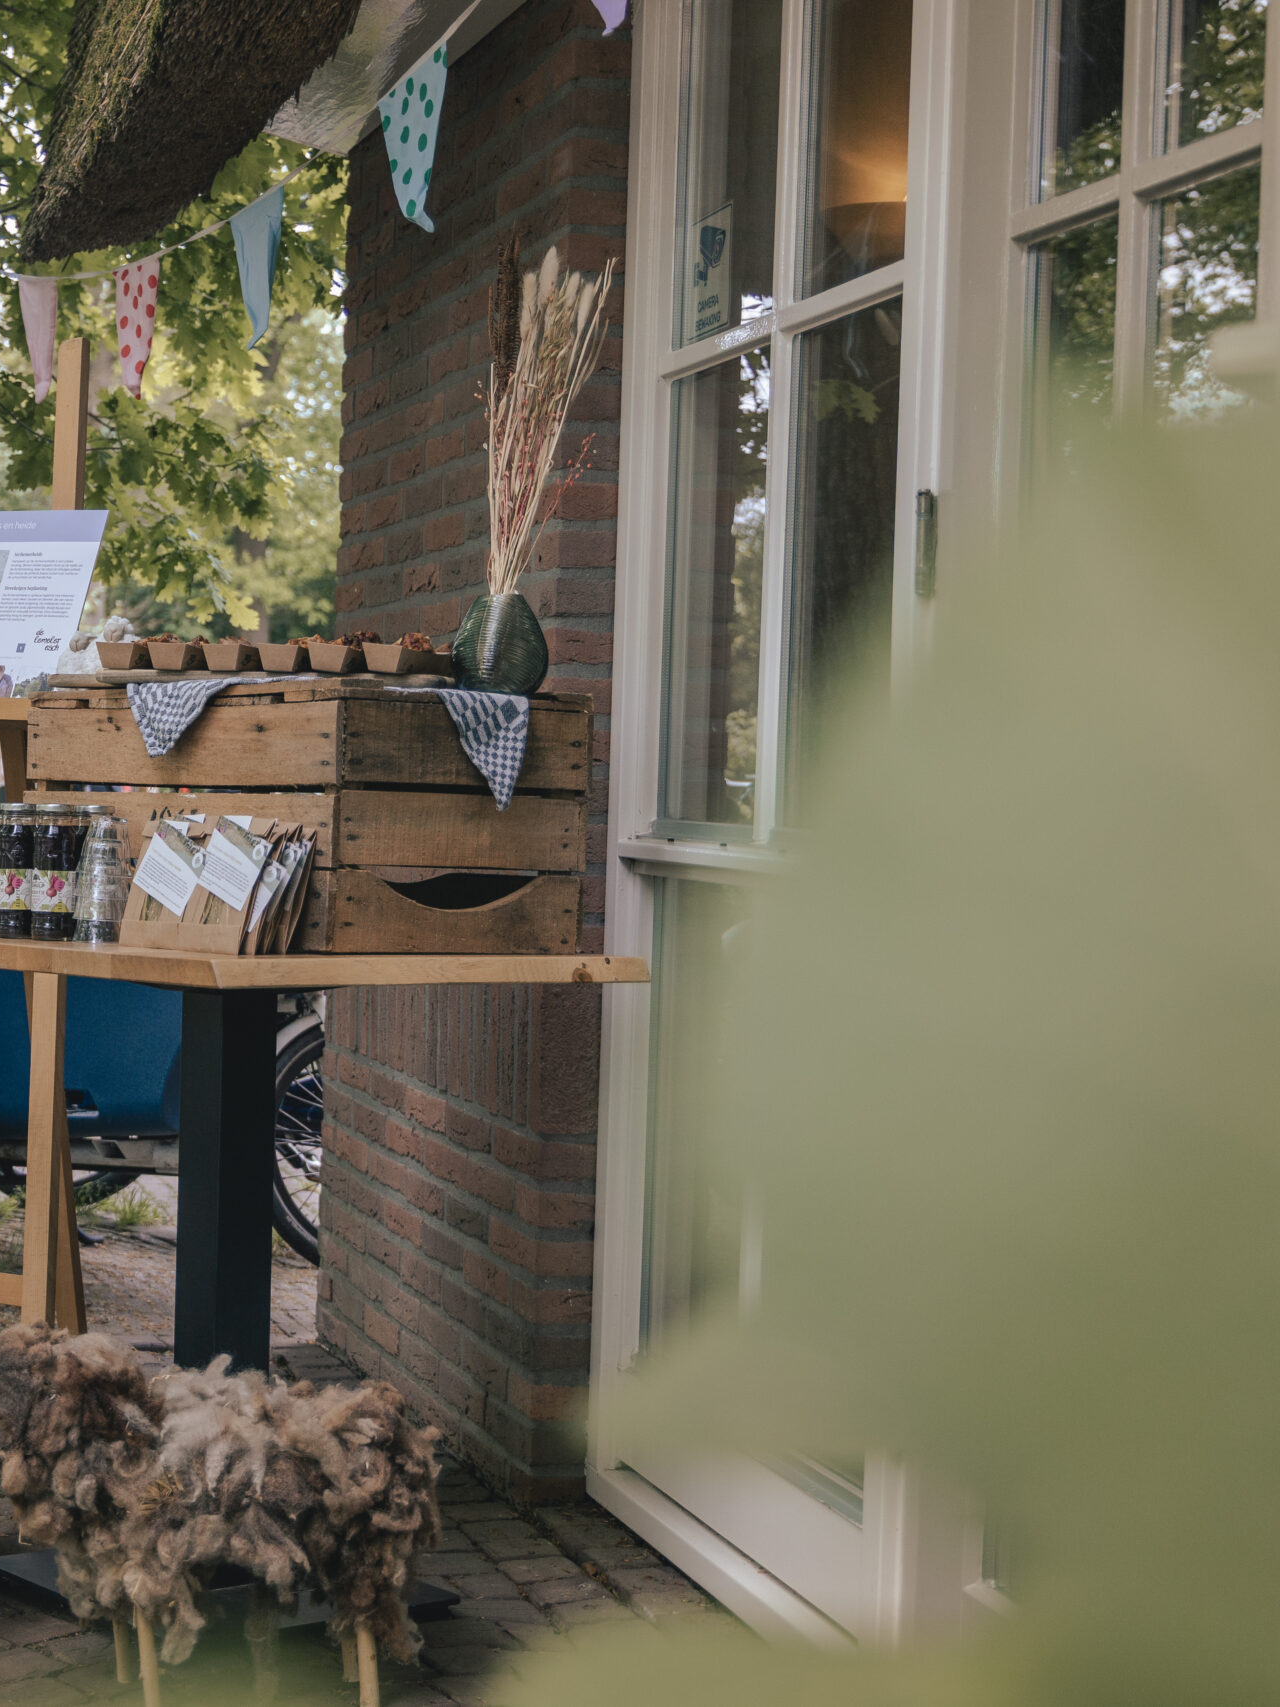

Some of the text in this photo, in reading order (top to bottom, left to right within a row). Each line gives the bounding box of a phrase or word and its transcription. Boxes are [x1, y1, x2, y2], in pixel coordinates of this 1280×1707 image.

[698, 294, 719, 313] CAMERA
[695, 311, 720, 332] BEWAKING
[3, 522, 14, 530] en
[14, 520, 37, 530] heide
